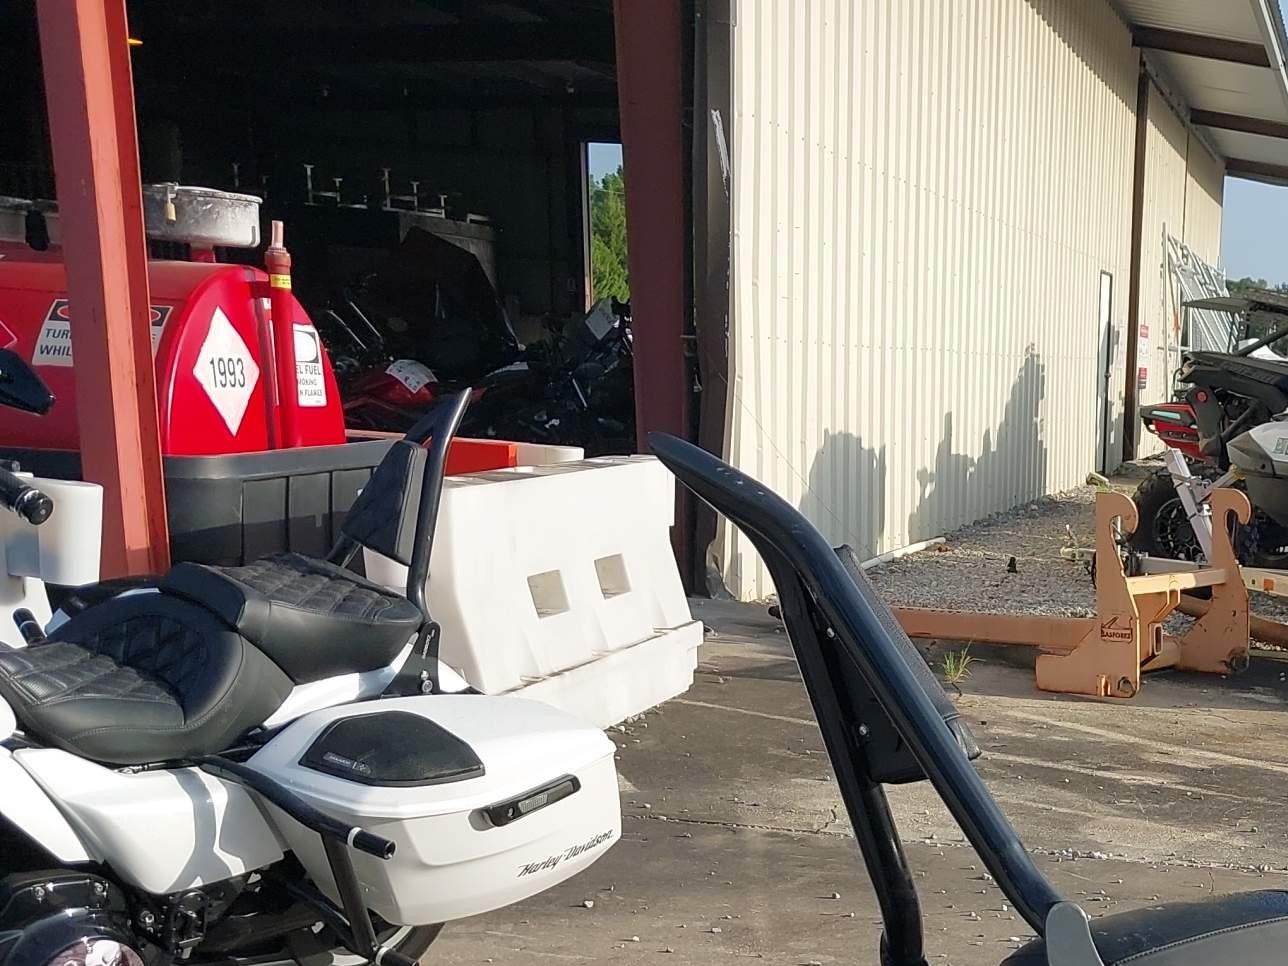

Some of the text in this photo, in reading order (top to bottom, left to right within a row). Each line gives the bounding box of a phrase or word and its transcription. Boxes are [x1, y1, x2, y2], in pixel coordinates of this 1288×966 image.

[46, 327, 72, 341] TUR
[40, 344, 73, 357] WHIL
[209, 357, 246, 388] 1993
[305, 364, 322, 376] FUEL
